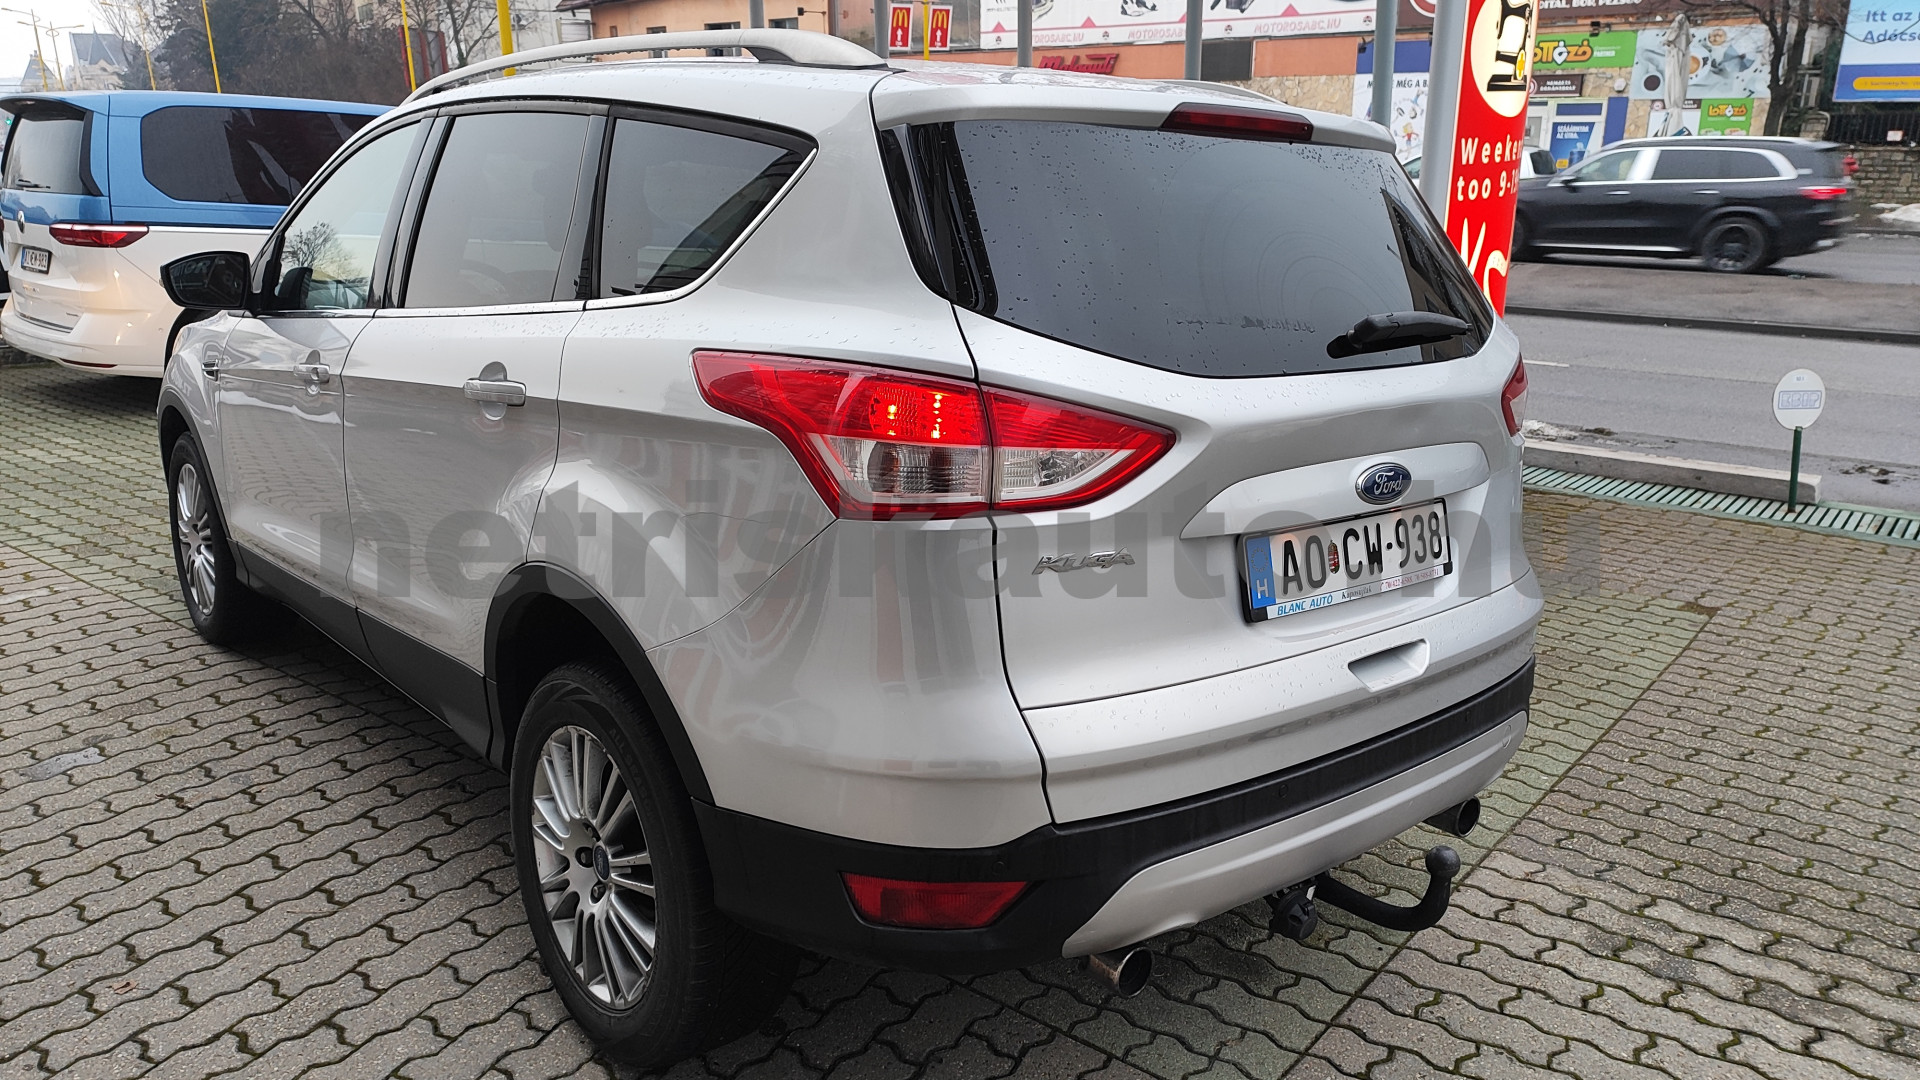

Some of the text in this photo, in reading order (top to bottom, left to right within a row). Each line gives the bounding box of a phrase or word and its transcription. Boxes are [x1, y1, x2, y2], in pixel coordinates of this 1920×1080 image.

[1866, 10, 1887, 22] Itt
[1892, 11, 1913, 22] az
[1128, 28, 1186, 40] MOTOROSAB
[1396, 77, 1413, 88] MÉG
[1415, 79, 1420, 88] A
[1457, 175, 1492, 202] too
[1373, 471, 1403, 496] Ford
[1342, 510, 1443, 580] CW-938
[1031, 547, 1135, 575] KUGA
[1257, 577, 1269, 600] H
[1277, 600, 1307, 616] BLANC
